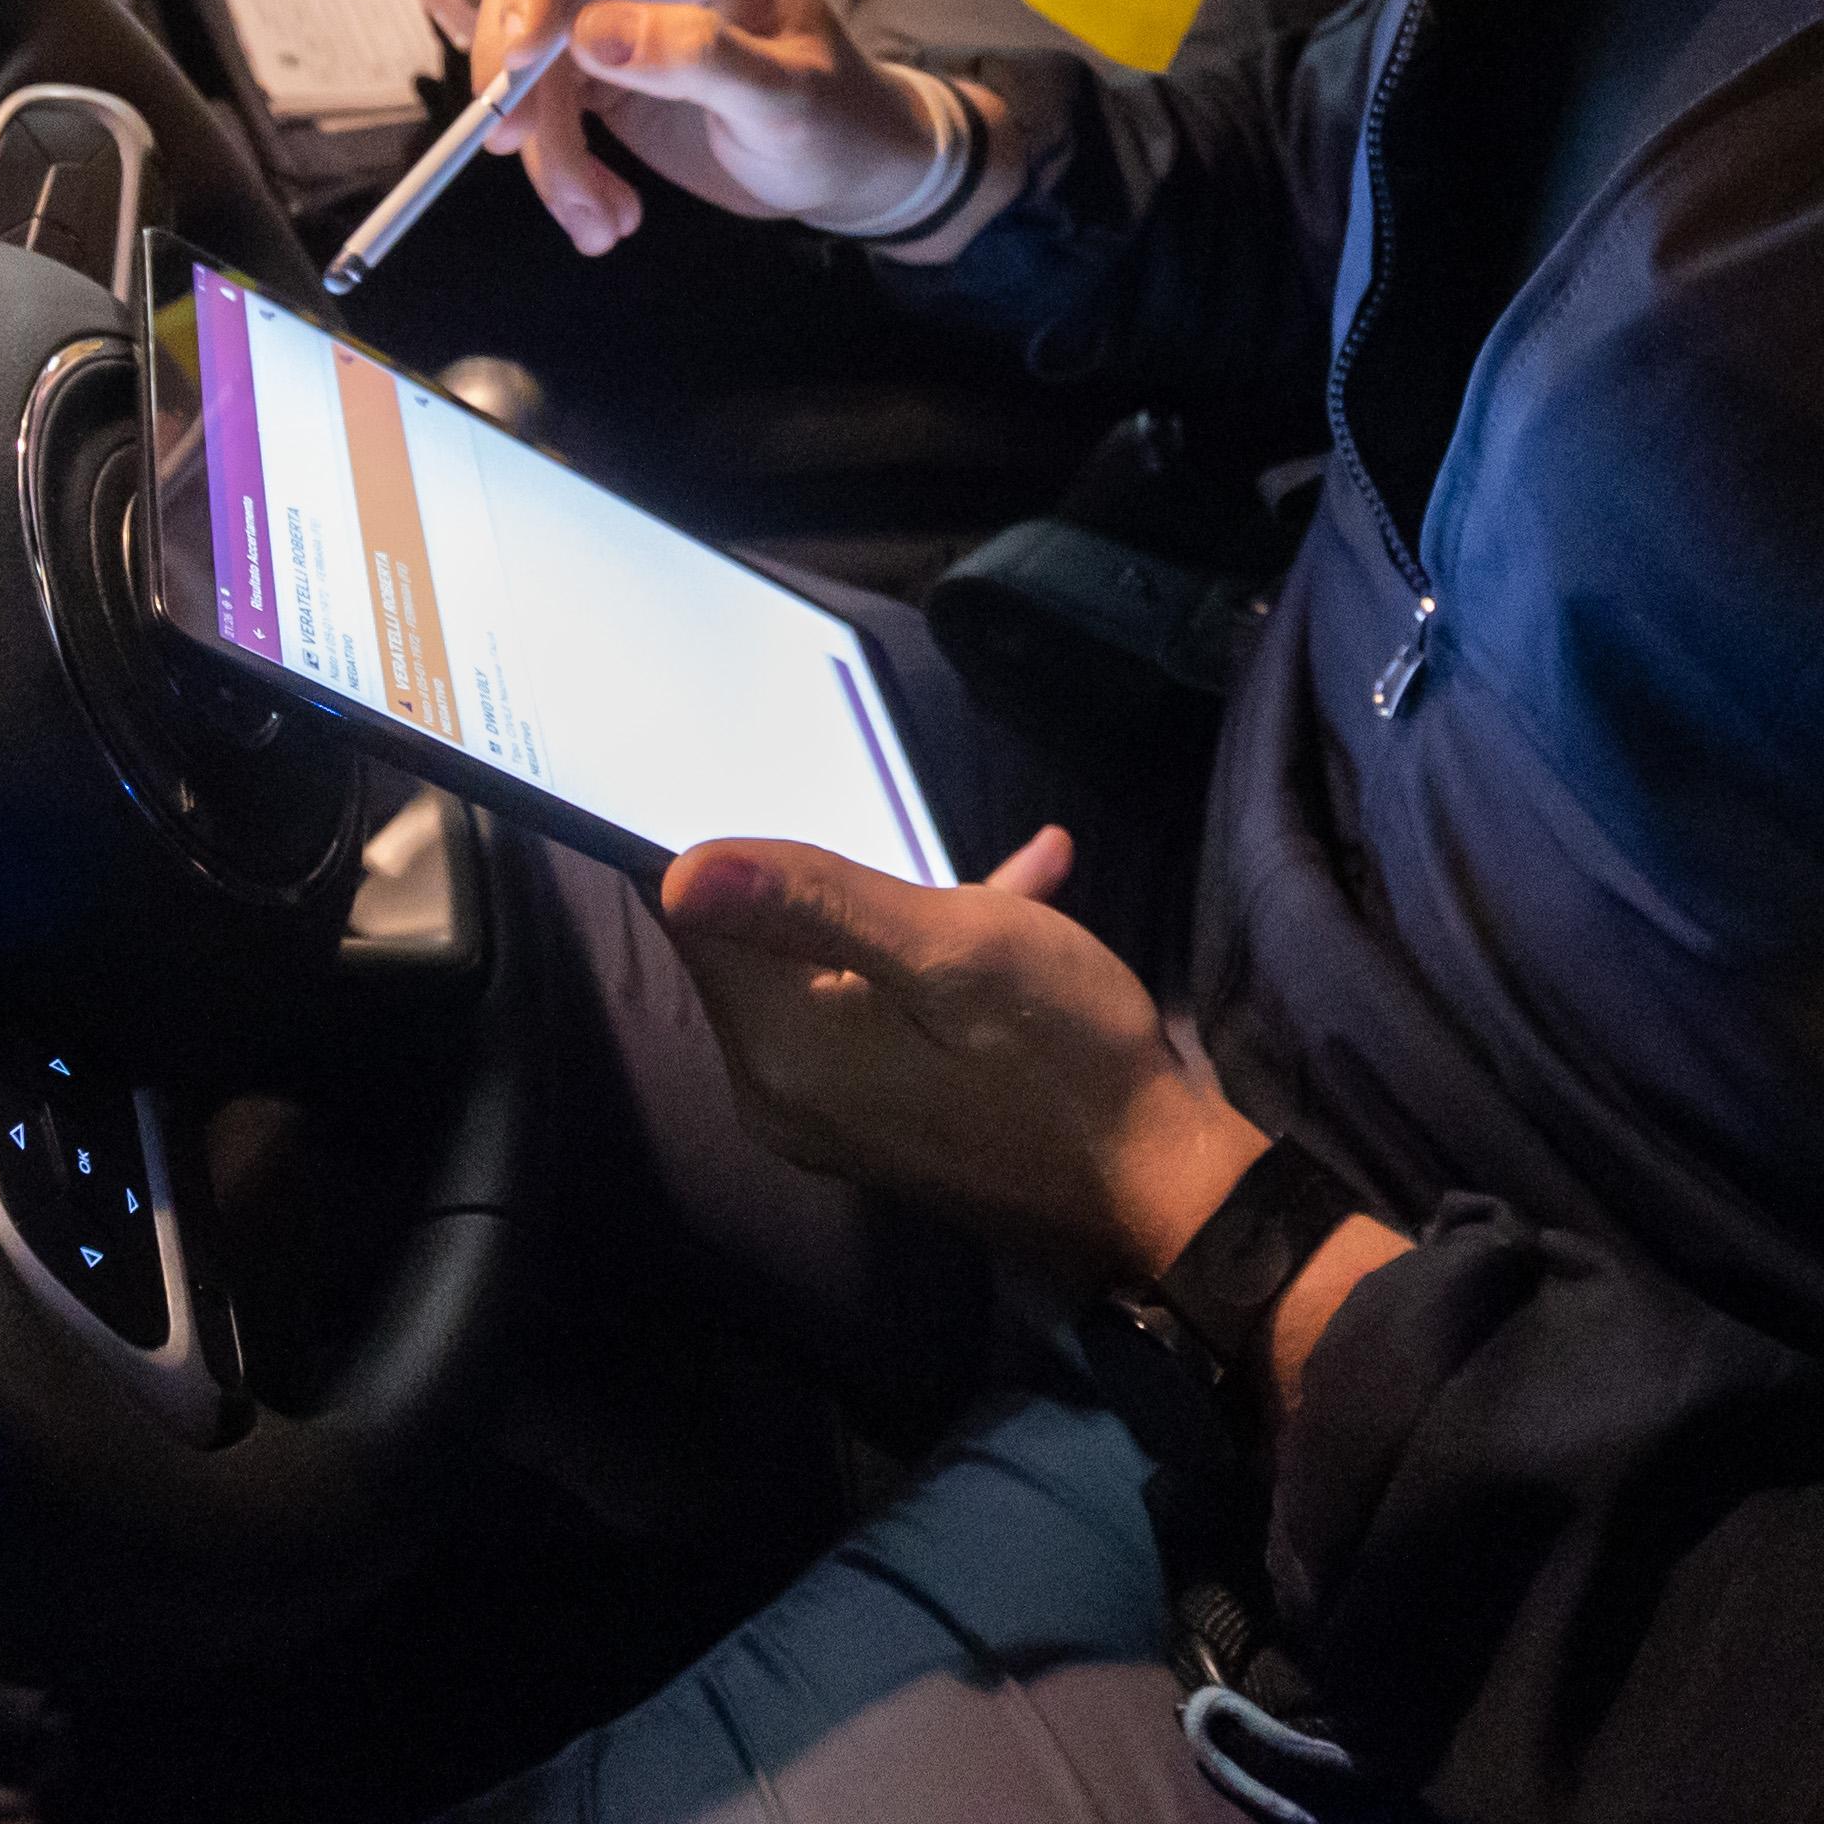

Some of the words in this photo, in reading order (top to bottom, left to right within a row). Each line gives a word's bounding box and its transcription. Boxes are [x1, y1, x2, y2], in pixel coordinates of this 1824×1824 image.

[242, 495, 259, 565] Accertamento
[287, 507, 306, 568] ROBERTA
[248, 563, 263, 612] Risultato
[293, 567, 316, 645] VERATELLI
[342, 633, 360, 691] NEGATIVO
[77, 1148, 91, 1174] OK
